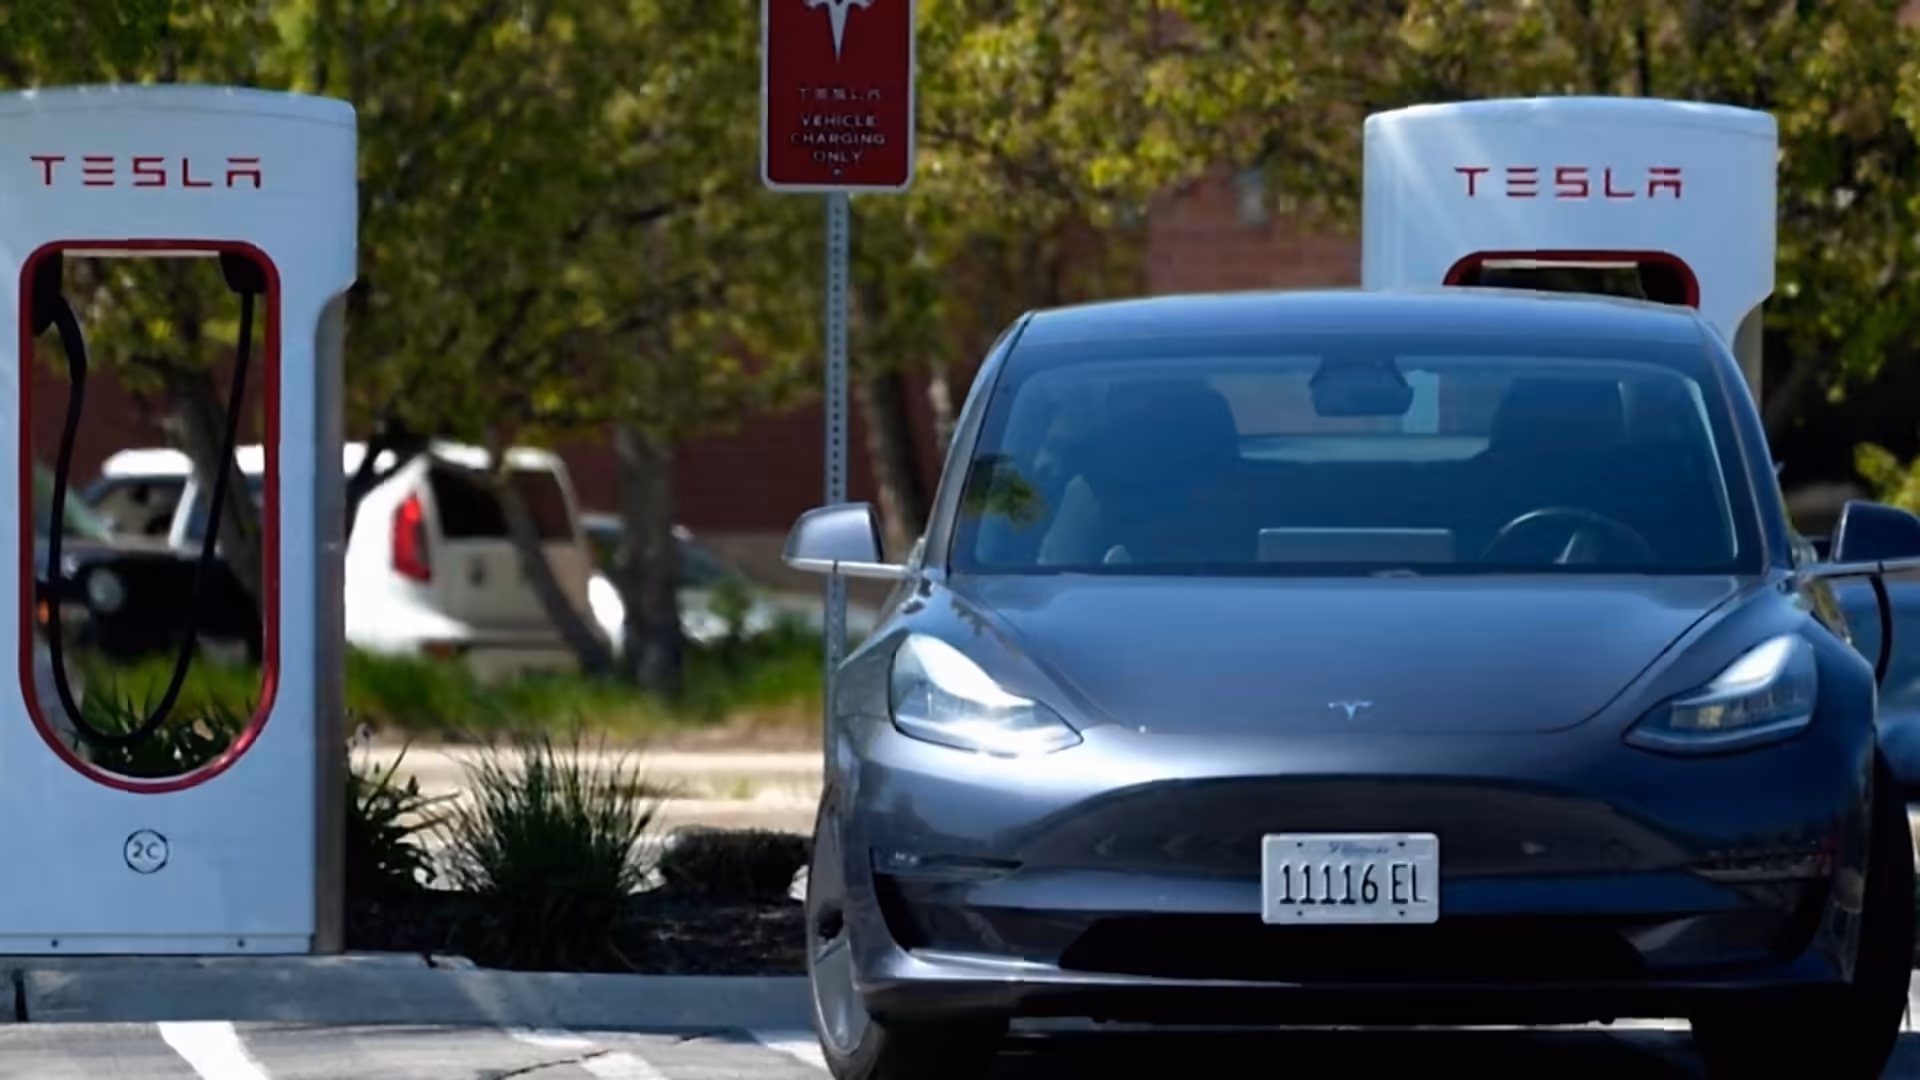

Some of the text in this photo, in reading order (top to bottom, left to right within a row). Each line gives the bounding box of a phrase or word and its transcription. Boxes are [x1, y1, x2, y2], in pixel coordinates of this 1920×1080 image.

[798, 87, 881, 101] TESLA
[801, 114, 876, 127] VEHICLE
[790, 132, 886, 146] CHARGING
[813, 150, 863, 163] ONLY
[30, 155, 262, 189] TESLA
[1454, 166, 1682, 199] TESLA
[132, 840, 161, 860] 2C
[1279, 862, 1429, 905] 11116 EL
